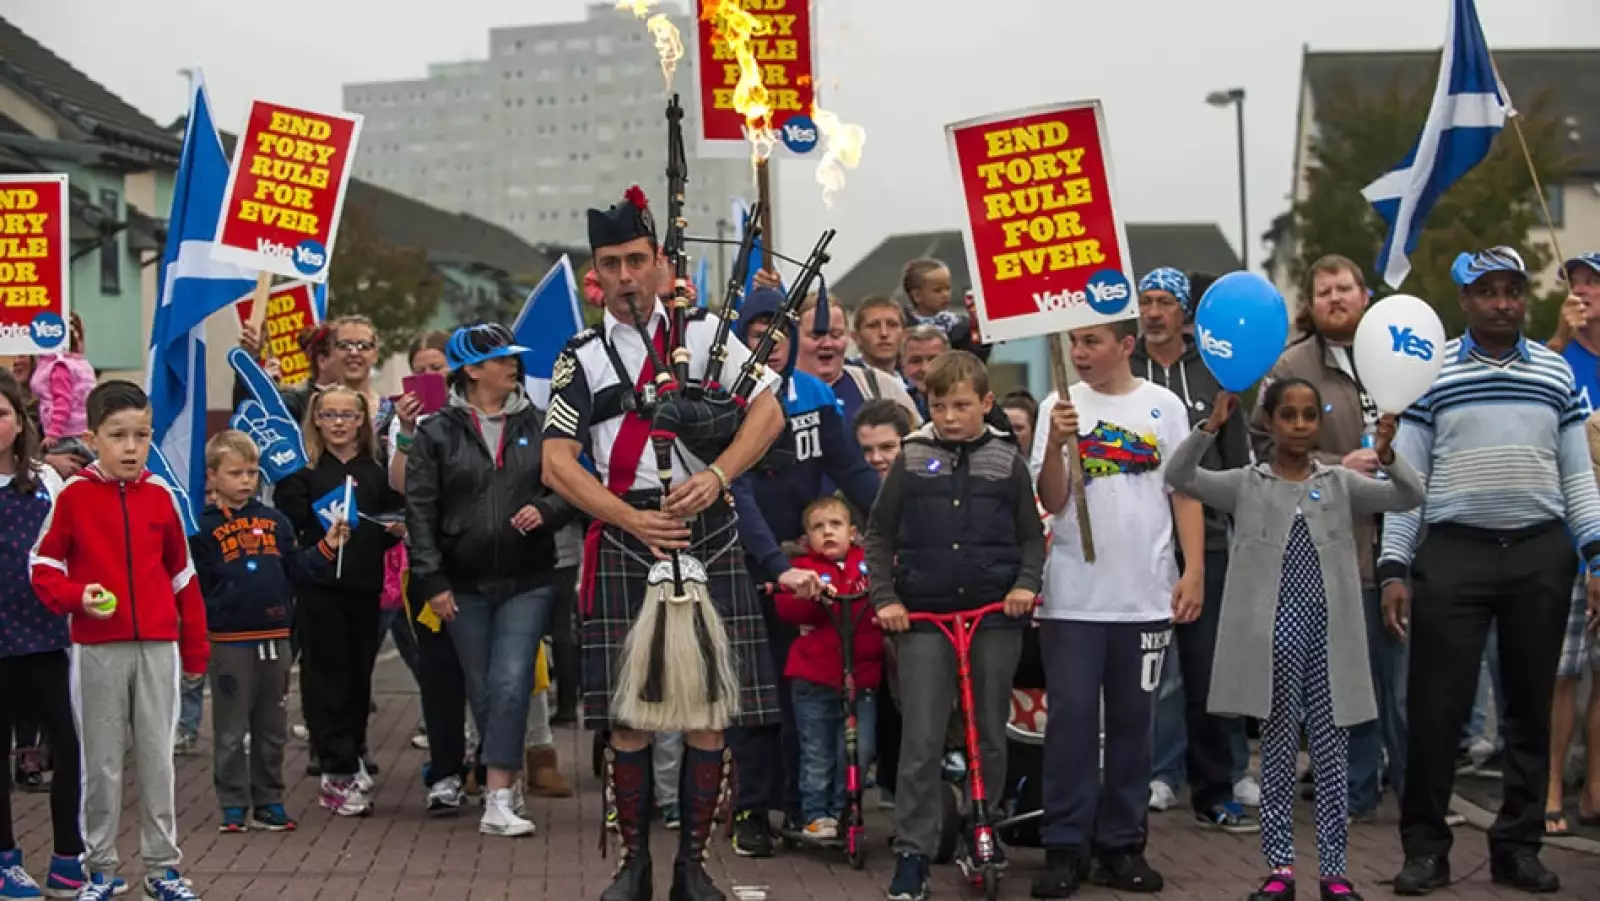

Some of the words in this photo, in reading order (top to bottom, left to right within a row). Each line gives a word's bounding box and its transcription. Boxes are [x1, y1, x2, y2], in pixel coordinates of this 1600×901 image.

[740, 0, 787, 11] ND
[723, 63, 789, 86] FR
[269, 111, 332, 141] END
[783, 123, 816, 143] Yes
[984, 120, 1069, 158] END
[257, 132, 336, 166] TORY
[250, 156, 331, 189] RULE
[977, 147, 1086, 189] TORY
[0, 189, 38, 210] ND
[254, 180, 314, 211] FOR
[983, 178, 1093, 221] RULE
[0, 213, 48, 234] RY
[237, 201, 319, 236] EVER
[1002, 211, 1086, 248] FOR
[0, 238, 48, 258] LE
[257, 237, 293, 259] Vote
[292, 244, 325, 267] Yes
[992, 239, 1107, 281] EVER
[0, 262, 39, 283] OR
[0, 286, 51, 307] ER
[267, 294, 295, 316] ND
[1032, 288, 1086, 314] Vote
[1086, 281, 1128, 304] Yes
[0, 321, 30, 338] ote
[31, 319, 63, 338] Yes
[267, 311, 305, 336] ORY
[1195, 324, 1233, 360] Yes
[1388, 325, 1435, 362] Yes
[280, 352, 311, 373] OR
[795, 426, 823, 462] 01
